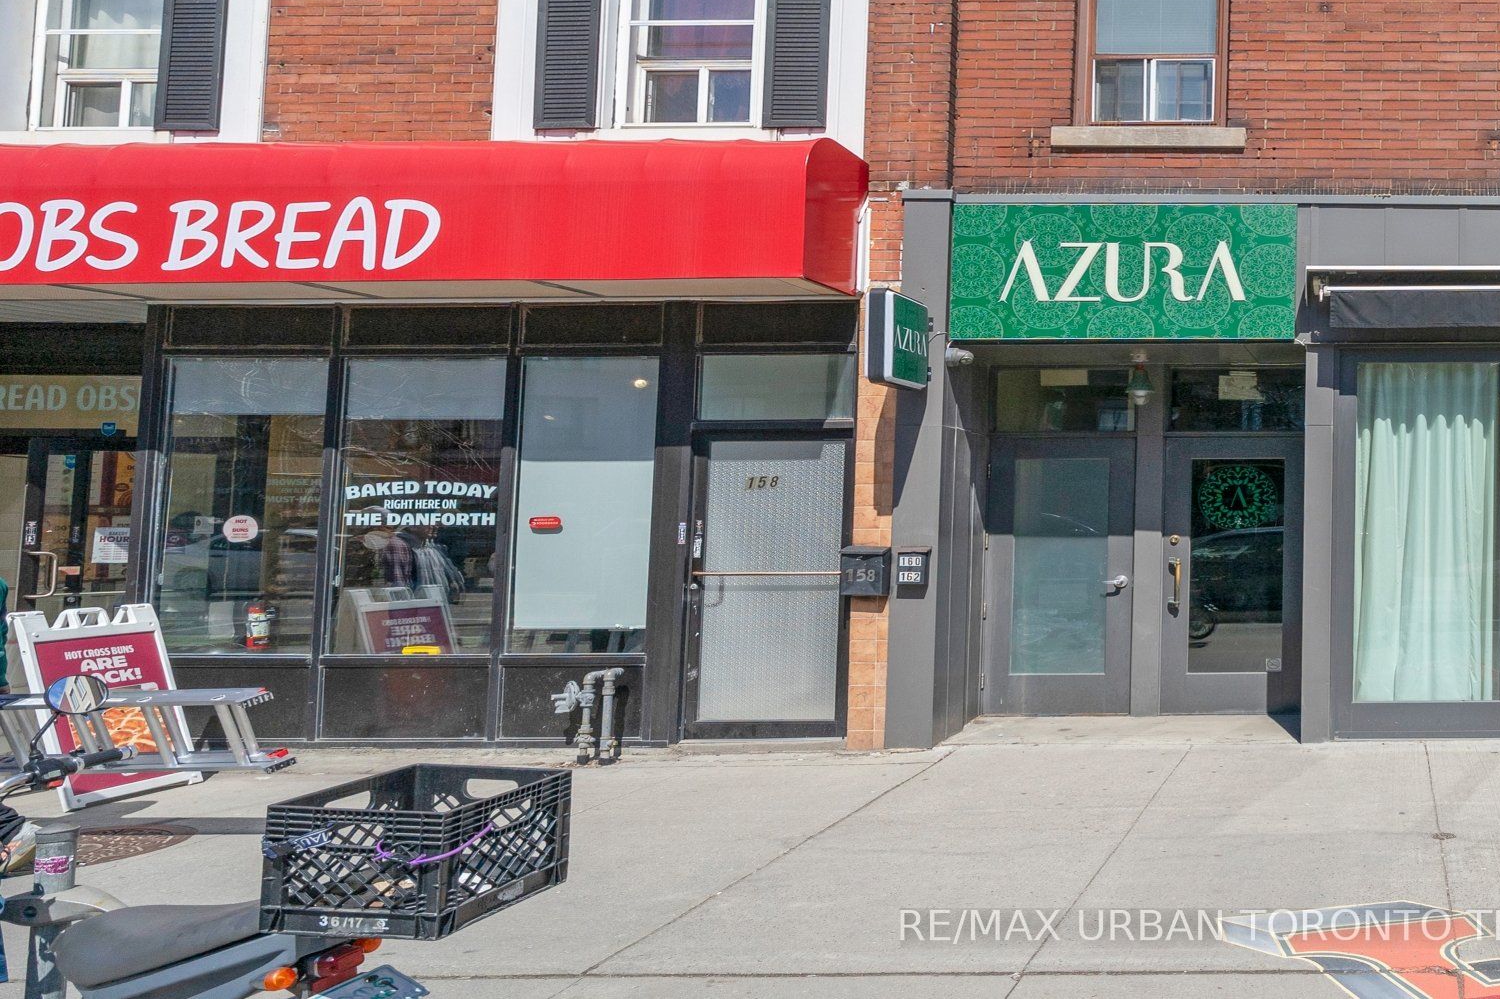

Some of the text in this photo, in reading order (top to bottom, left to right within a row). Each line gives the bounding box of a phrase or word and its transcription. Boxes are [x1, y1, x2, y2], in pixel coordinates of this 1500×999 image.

[161, 196, 441, 271] BREAD
[998, 238, 1247, 303] AZURA
[894, 324, 927, 357] AZURA
[345, 480, 497, 499] BAKED TODAY
[748, 475, 779, 489] 158
[384, 499, 457, 510] RIGHT HERE ON
[344, 512, 496, 526] THE DANFORTH
[902, 557, 920, 566] 160
[845, 568, 876, 582] 158
[901, 572, 920, 581] 162
[64, 644, 135, 660] HOT CROSS BUNS
[81, 655, 128, 672] ARE
